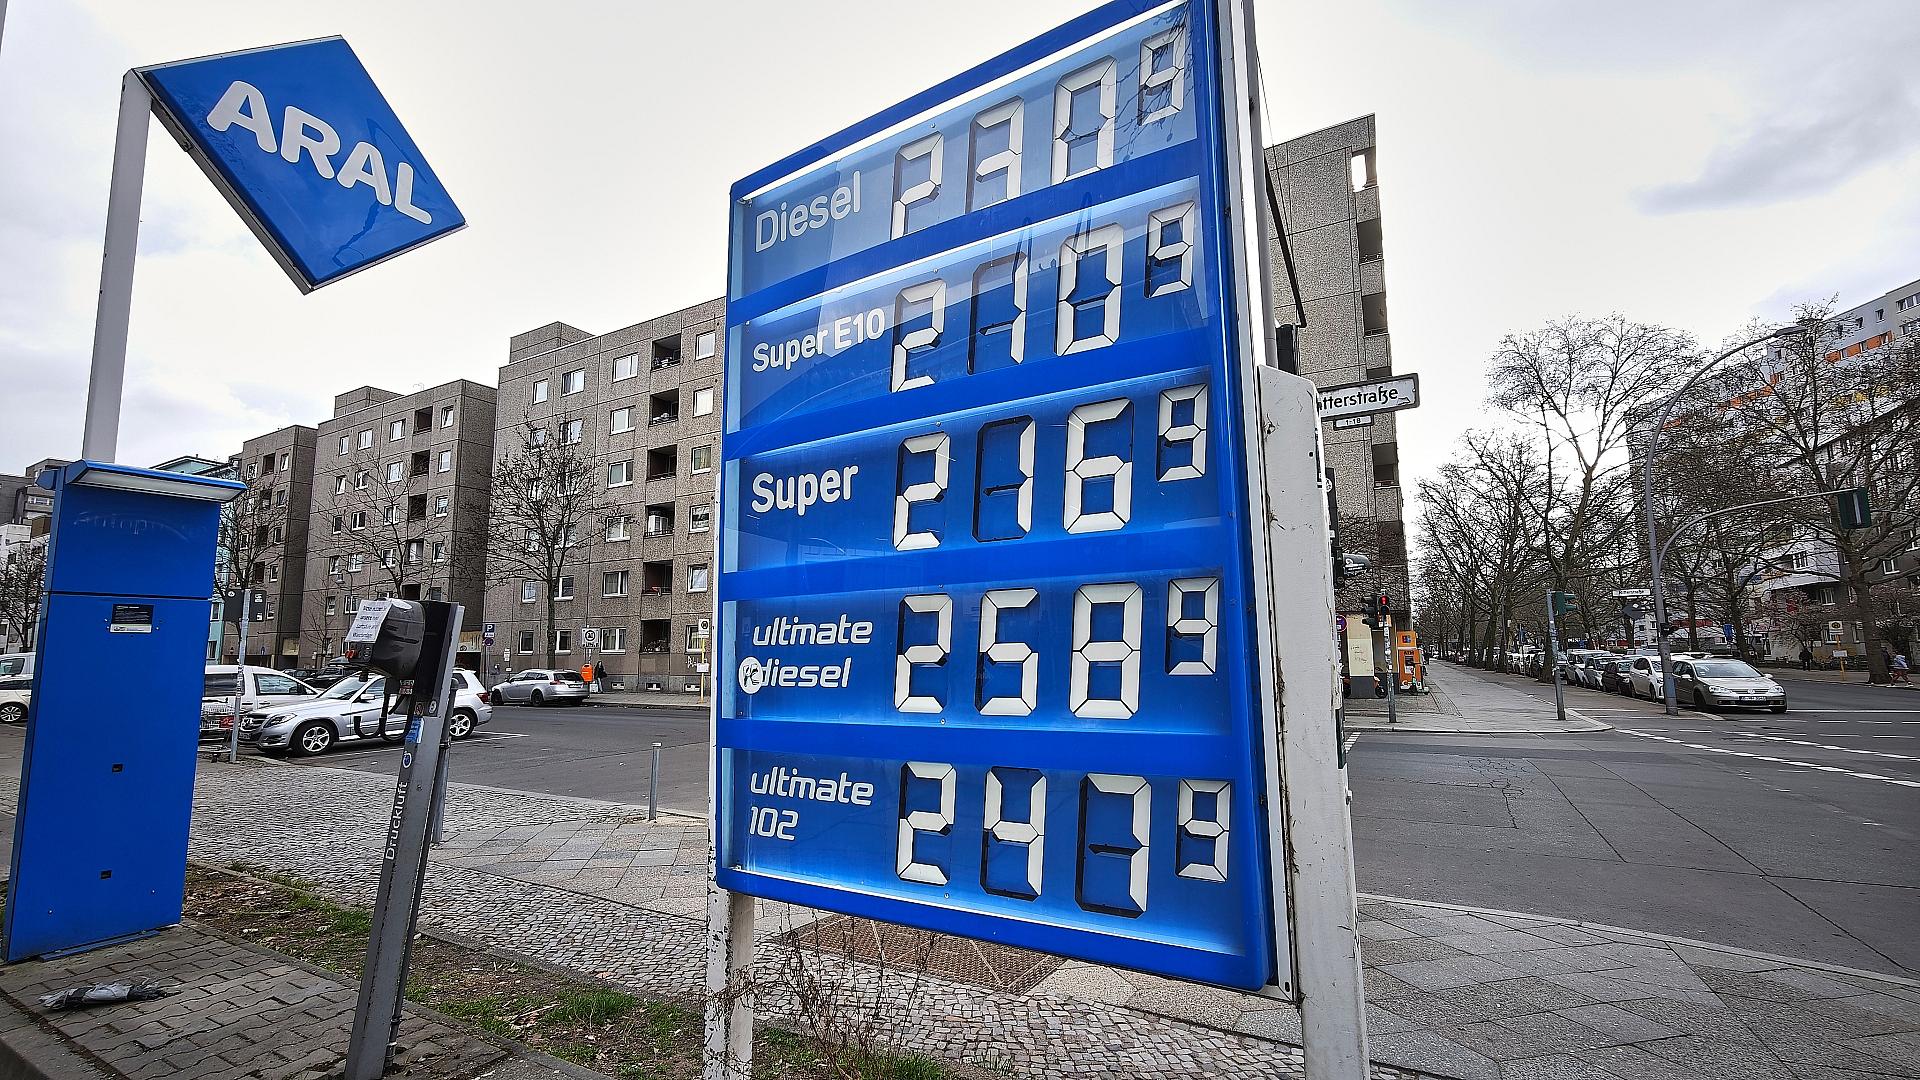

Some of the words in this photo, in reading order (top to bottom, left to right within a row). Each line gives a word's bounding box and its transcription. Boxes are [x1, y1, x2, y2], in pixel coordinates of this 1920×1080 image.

[206, 80, 432, 225] ARAL
[756, 171, 861, 253] Diesel
[752, 328, 829, 372] Super
[834, 308, 886, 350] E10
[752, 464, 858, 516] Super
[753, 614, 873, 646] ultimate
[758, 657, 852, 688] diesel
[750, 766, 874, 806] ultimate
[385, 782, 409, 861] Druckluft
[750, 806, 799, 841] 102
